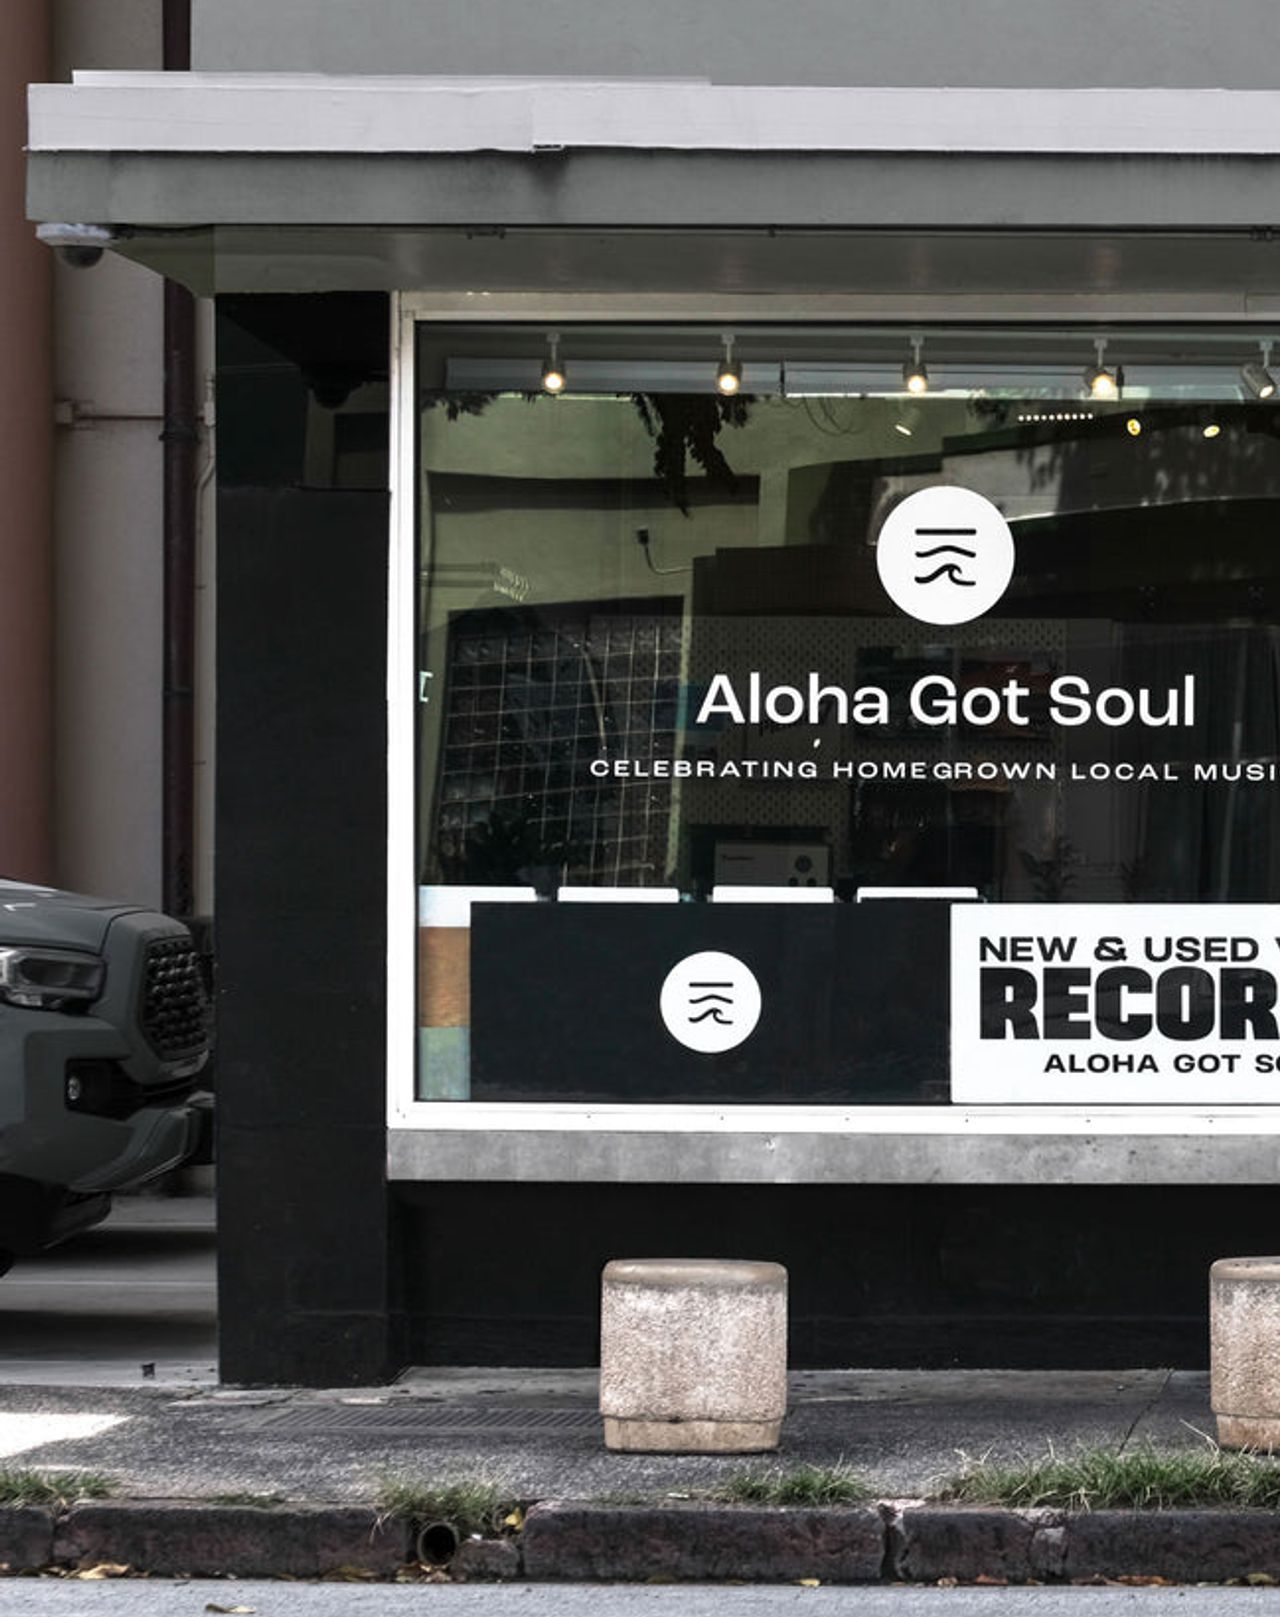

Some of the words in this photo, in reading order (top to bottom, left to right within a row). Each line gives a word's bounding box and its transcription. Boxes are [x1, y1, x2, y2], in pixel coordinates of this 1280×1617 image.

[696, 672, 889, 725] Aloha
[909, 674, 1030, 726] Got
[1048, 674, 1196, 727] Soul
[589, 759, 819, 779] CELEBRATING
[832, 761, 1057, 780] HOMEGROWN
[1070, 762, 1179, 781] LOCAL
[979, 936, 1077, 963] NEW
[1093, 936, 1128, 963] &
[1144, 936, 1260, 963] USED
[1043, 1053, 1160, 1074] ALOHA
[1172, 1053, 1241, 1074] GOT
